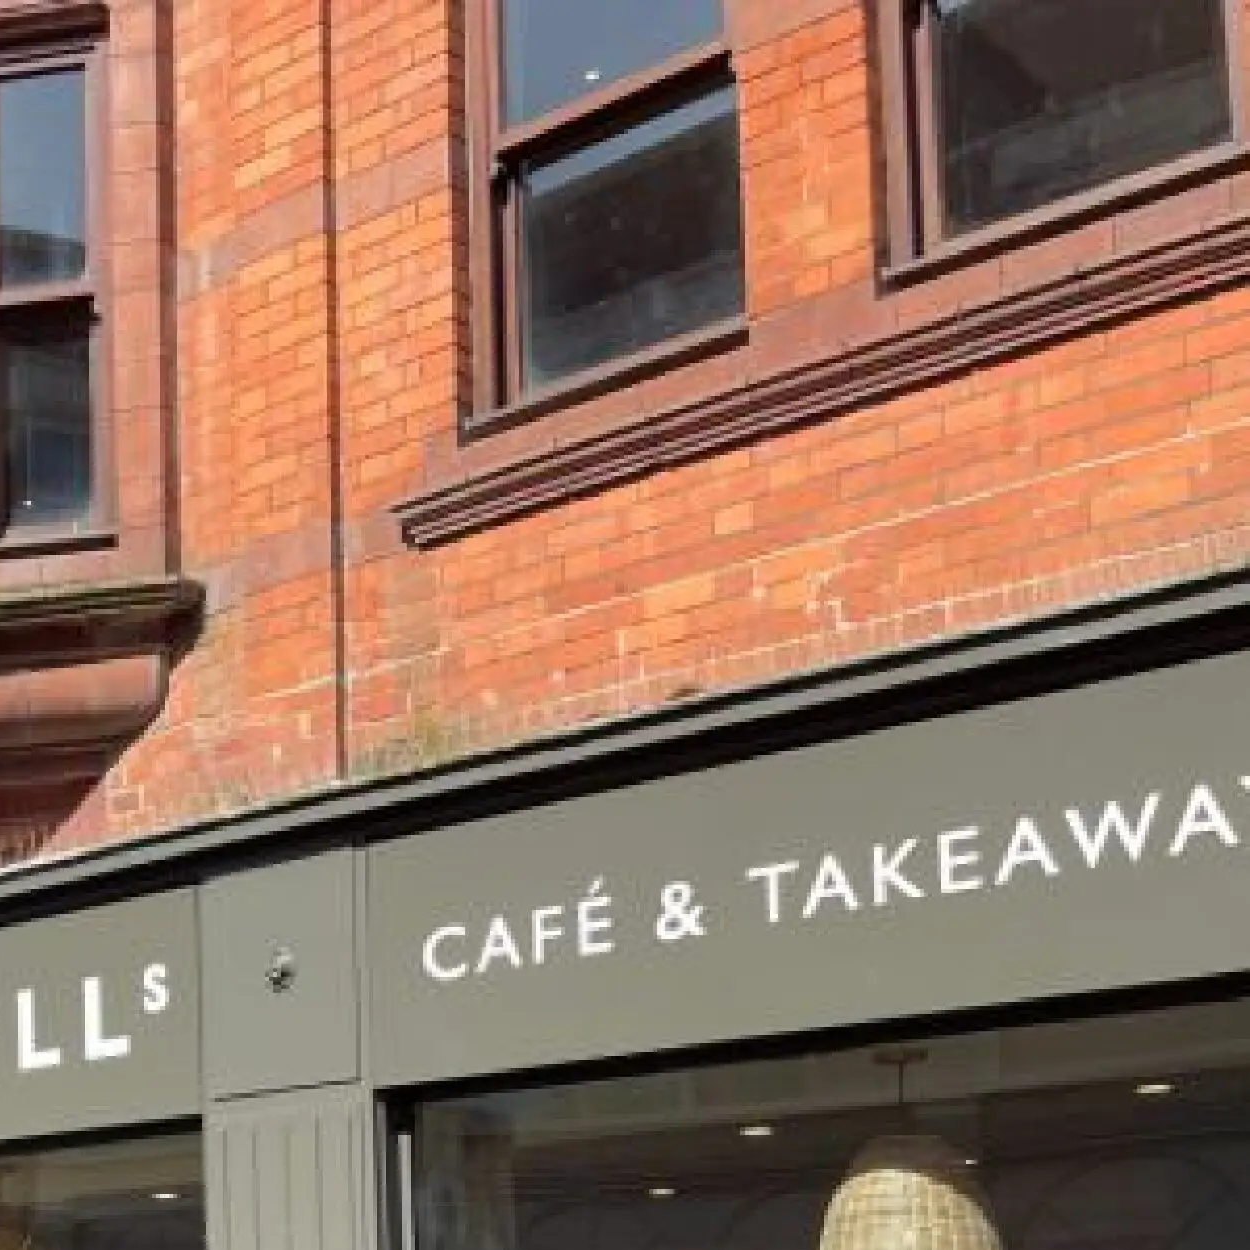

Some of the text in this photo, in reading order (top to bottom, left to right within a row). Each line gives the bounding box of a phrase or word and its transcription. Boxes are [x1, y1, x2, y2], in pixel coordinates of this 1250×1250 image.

[421, 774, 1250, 982] CAFÉ & TAKEAWA
